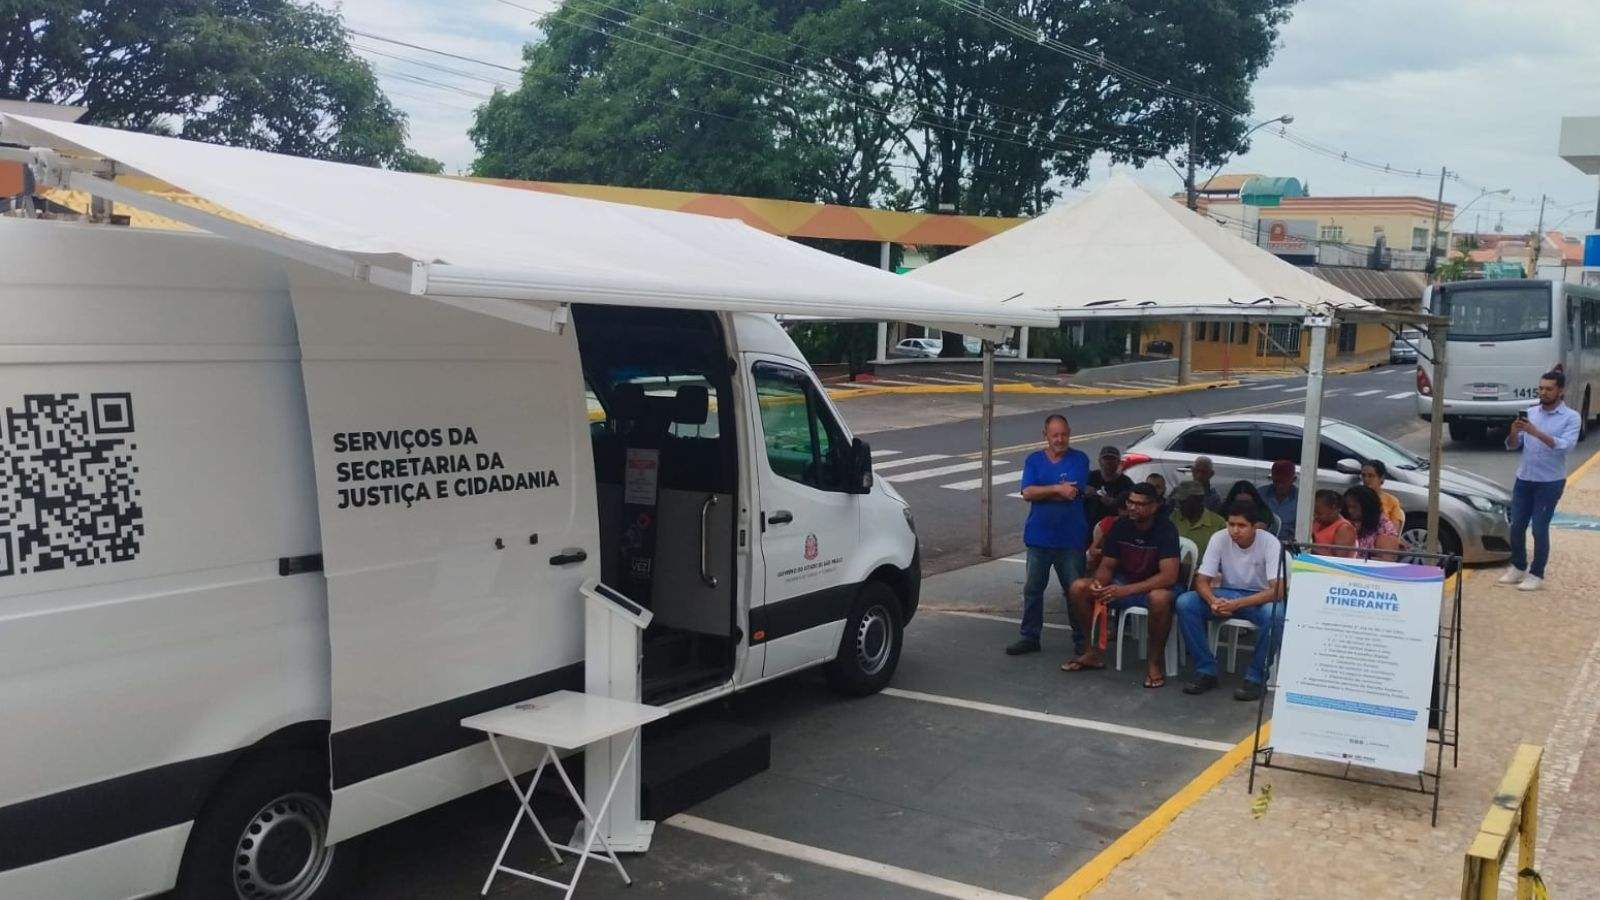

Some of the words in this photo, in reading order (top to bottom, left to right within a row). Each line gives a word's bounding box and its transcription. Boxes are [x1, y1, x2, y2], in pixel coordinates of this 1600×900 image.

[333, 428, 443, 454] SERVIÇOS
[448, 427, 478, 446] DA
[337, 455, 471, 482] SECRETARIA
[476, 452, 504, 471] DA
[338, 482, 431, 508] JUSTIÇA
[436, 480, 449, 498] E
[454, 470, 560, 497] CIDADANIA
[1326, 596, 1400, 612] ITINERANTE
[1329, 586, 1398, 601] CIDADANIA
